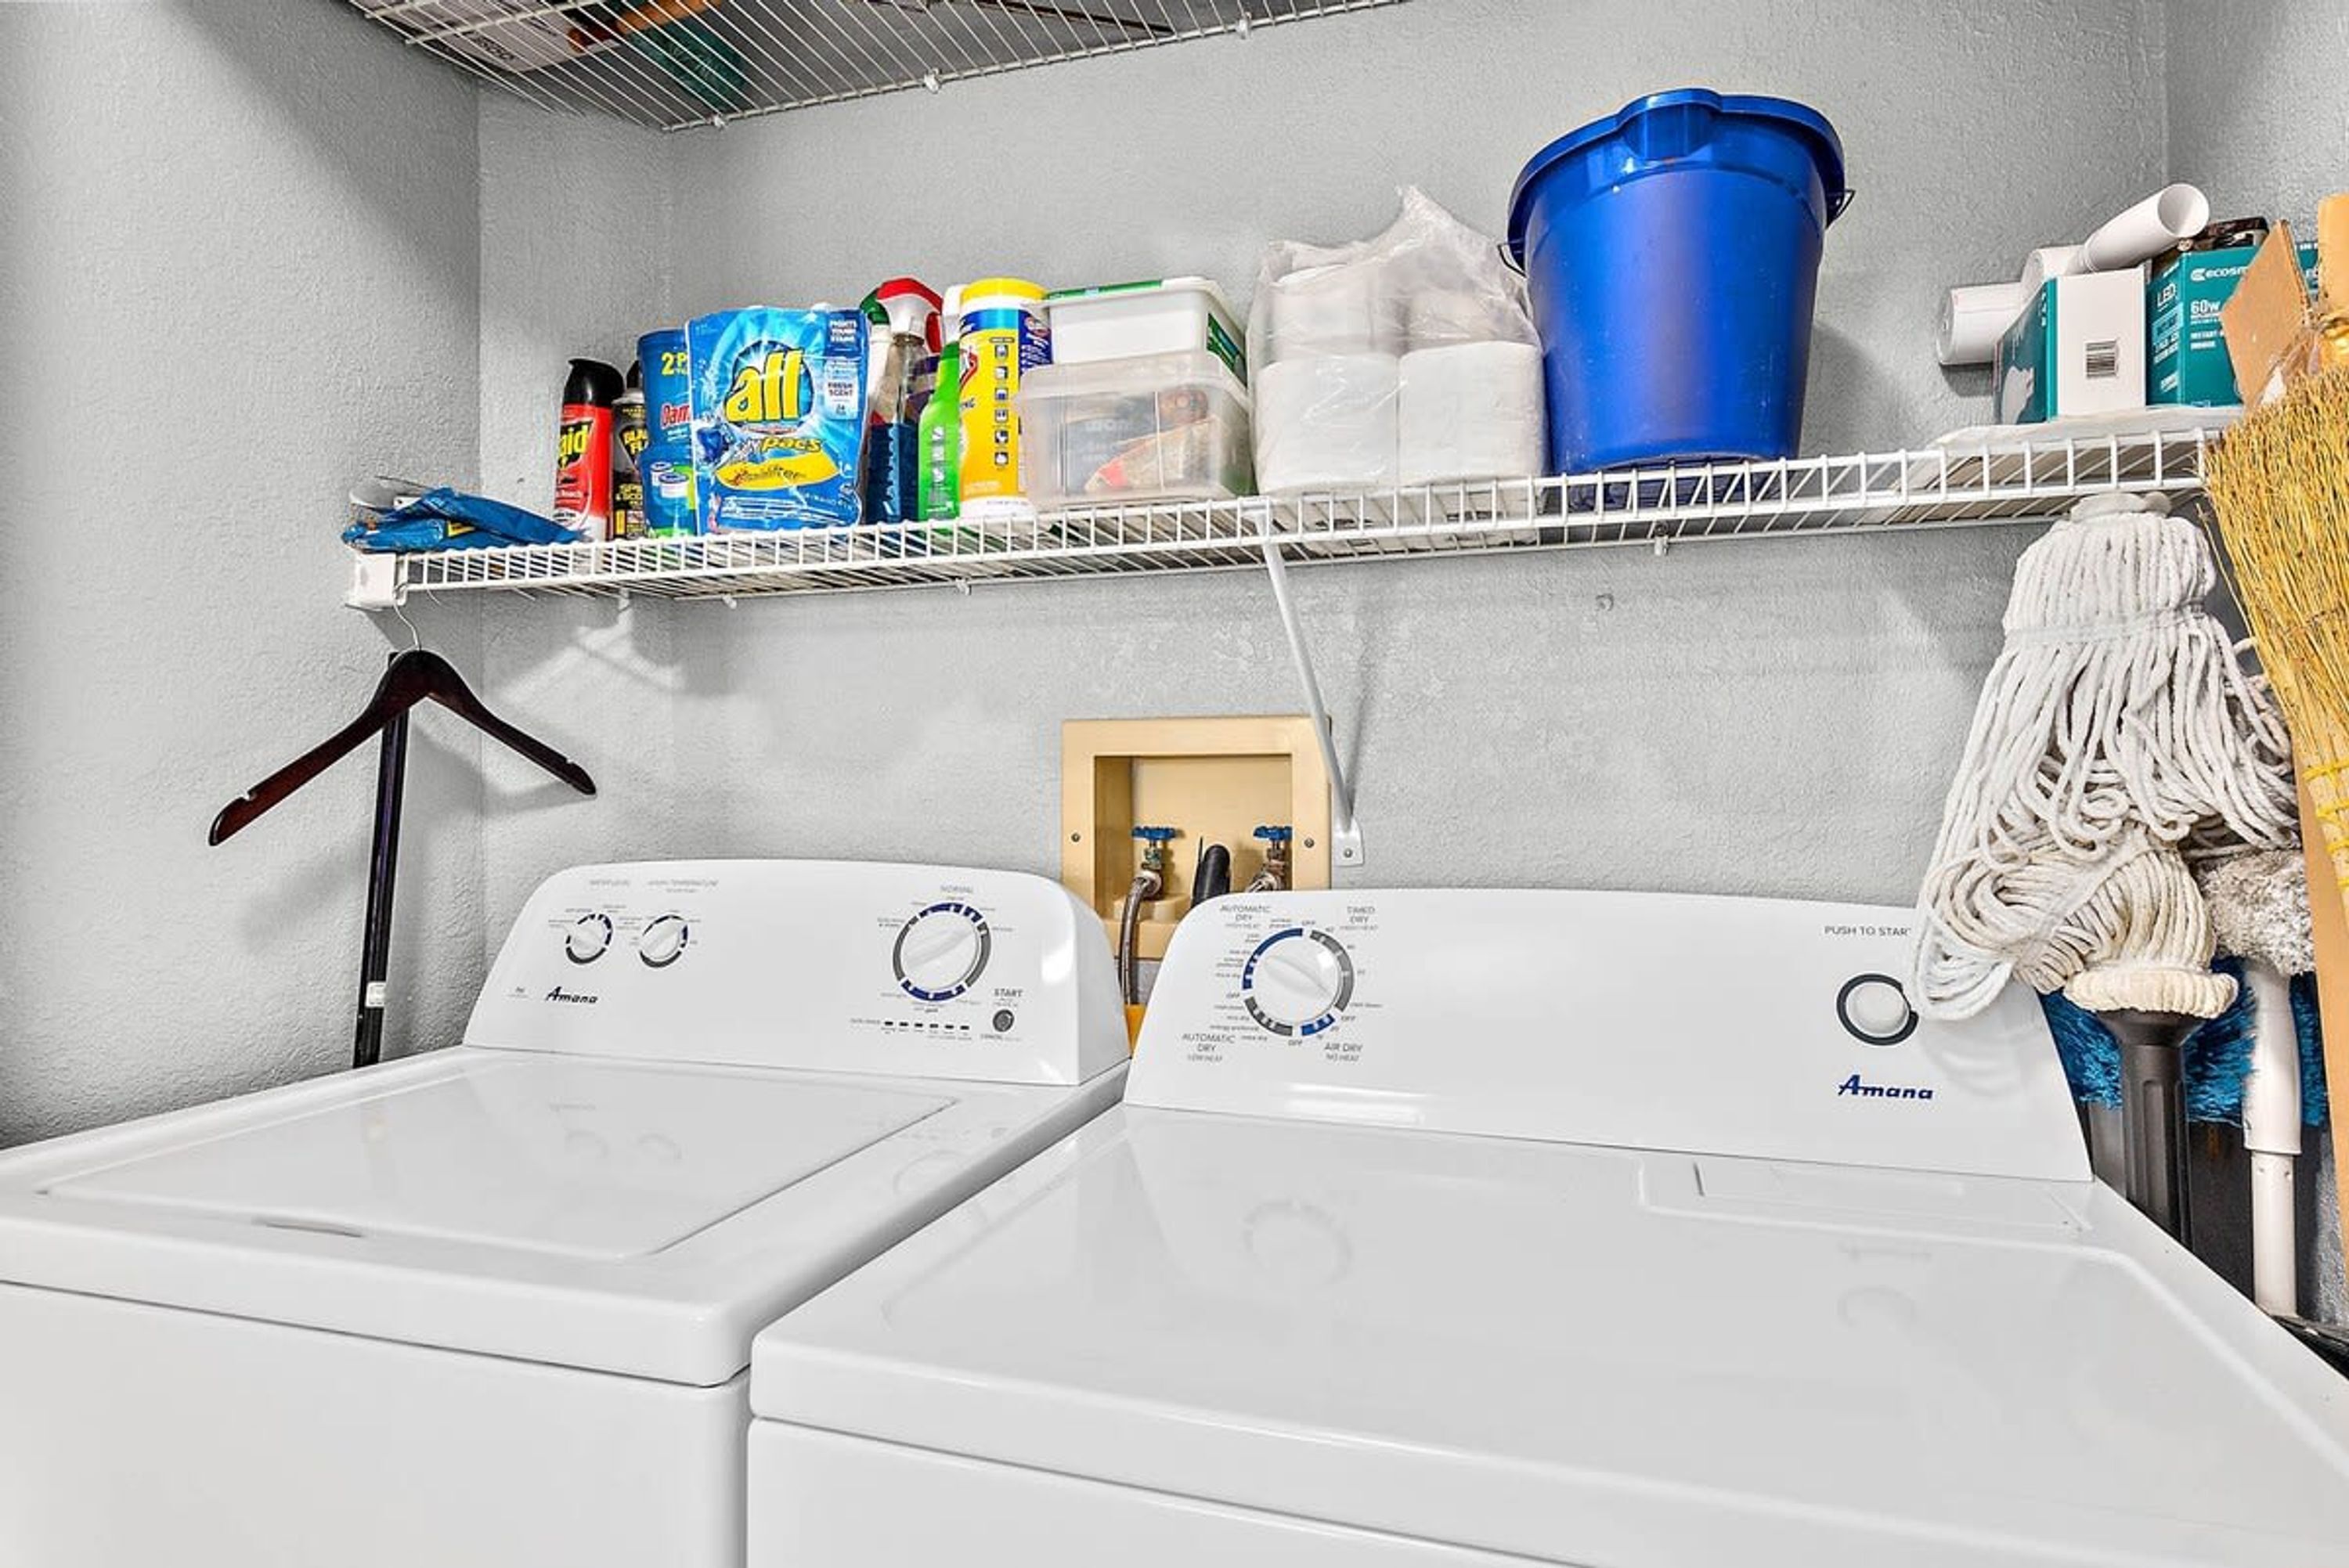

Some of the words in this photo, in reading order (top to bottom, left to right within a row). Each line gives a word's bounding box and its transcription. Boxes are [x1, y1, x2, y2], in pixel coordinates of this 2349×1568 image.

[2157, 283, 2177, 307] LED
[661, 352, 674, 375] 2
[723, 350, 805, 424] all
[558, 425, 589, 456] aid
[760, 437, 821, 452] pacs
[1219, 905, 1272, 914] AUTOMATIC
[1349, 915, 1369, 925] DRY
[1824, 926, 1856, 935] PUSH
[1860, 926, 1876, 935] TO
[546, 986, 598, 1004] Amana
[994, 989, 1023, 997] START
[1182, 1033, 1236, 1044] AUTOMATIC
[1197, 1044, 1217, 1052] DRY
[1324, 1043, 1340, 1051] AIR
[1342, 1043, 1363, 1052] DRY
[1838, 1074, 1934, 1100] Amana
